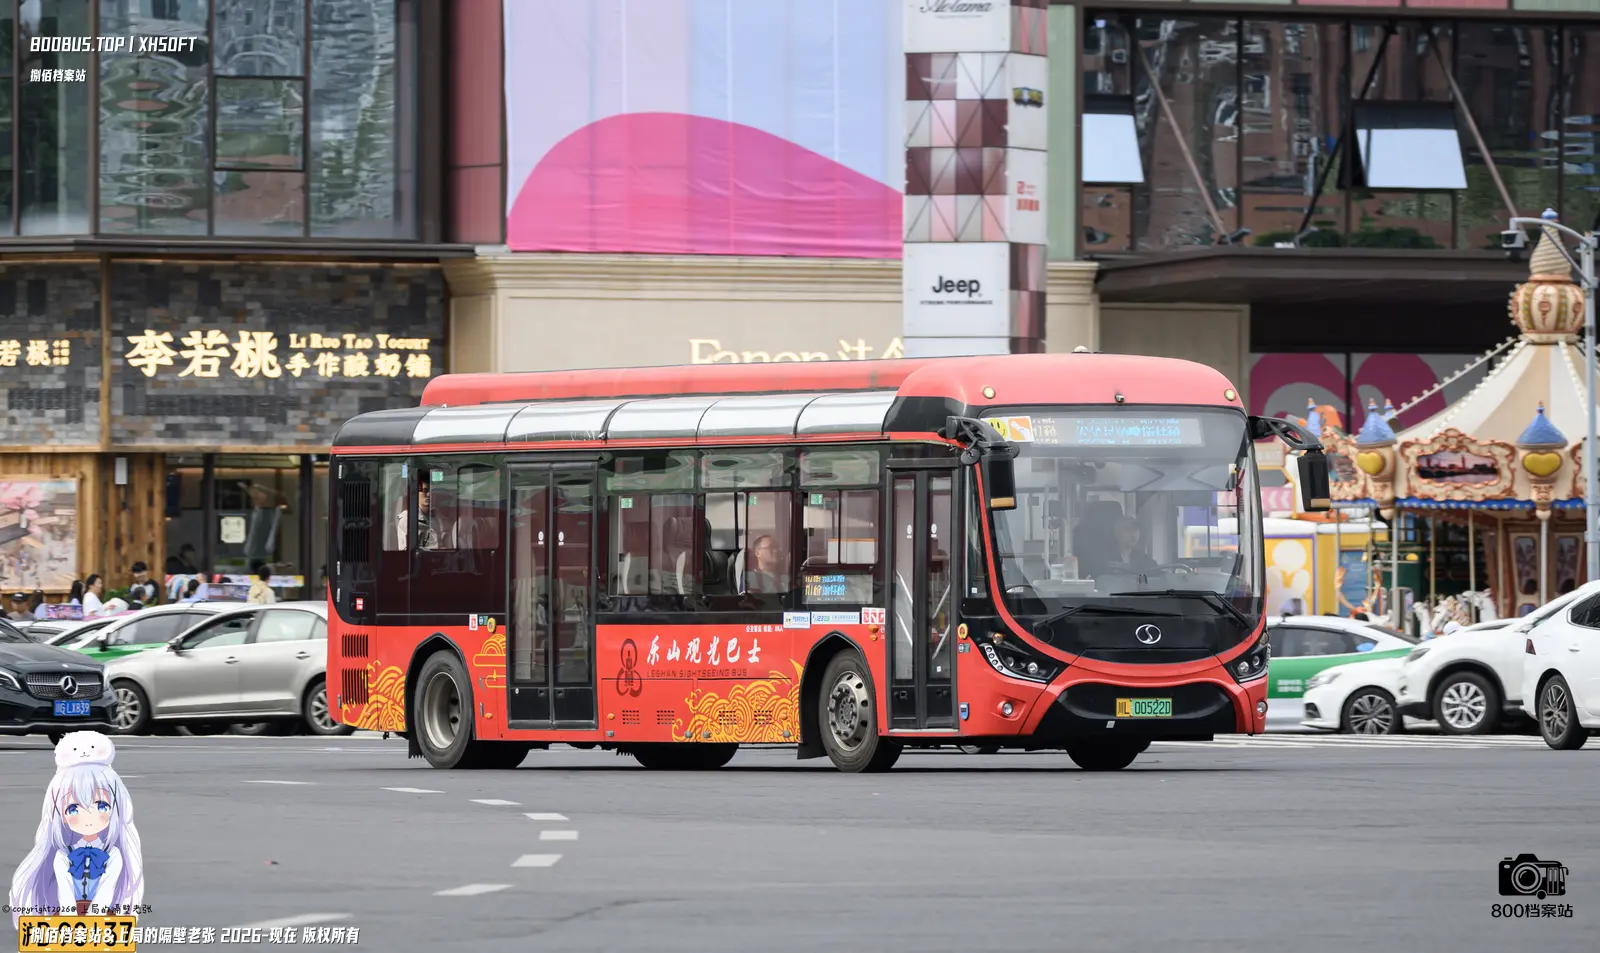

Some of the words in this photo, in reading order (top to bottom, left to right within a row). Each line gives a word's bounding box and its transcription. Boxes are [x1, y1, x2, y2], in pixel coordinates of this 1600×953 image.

[932, 276, 980, 297] Jeep
[125, 329, 282, 378] 李若桃
[285, 352, 431, 378] 手作酸奶铺
[646, 635, 761, 666] 乐山观光巴士
[646, 669, 677, 678] LESHAN
[679, 669, 730, 678] SIGHTSEEING
[731, 668, 747, 677] BUS
